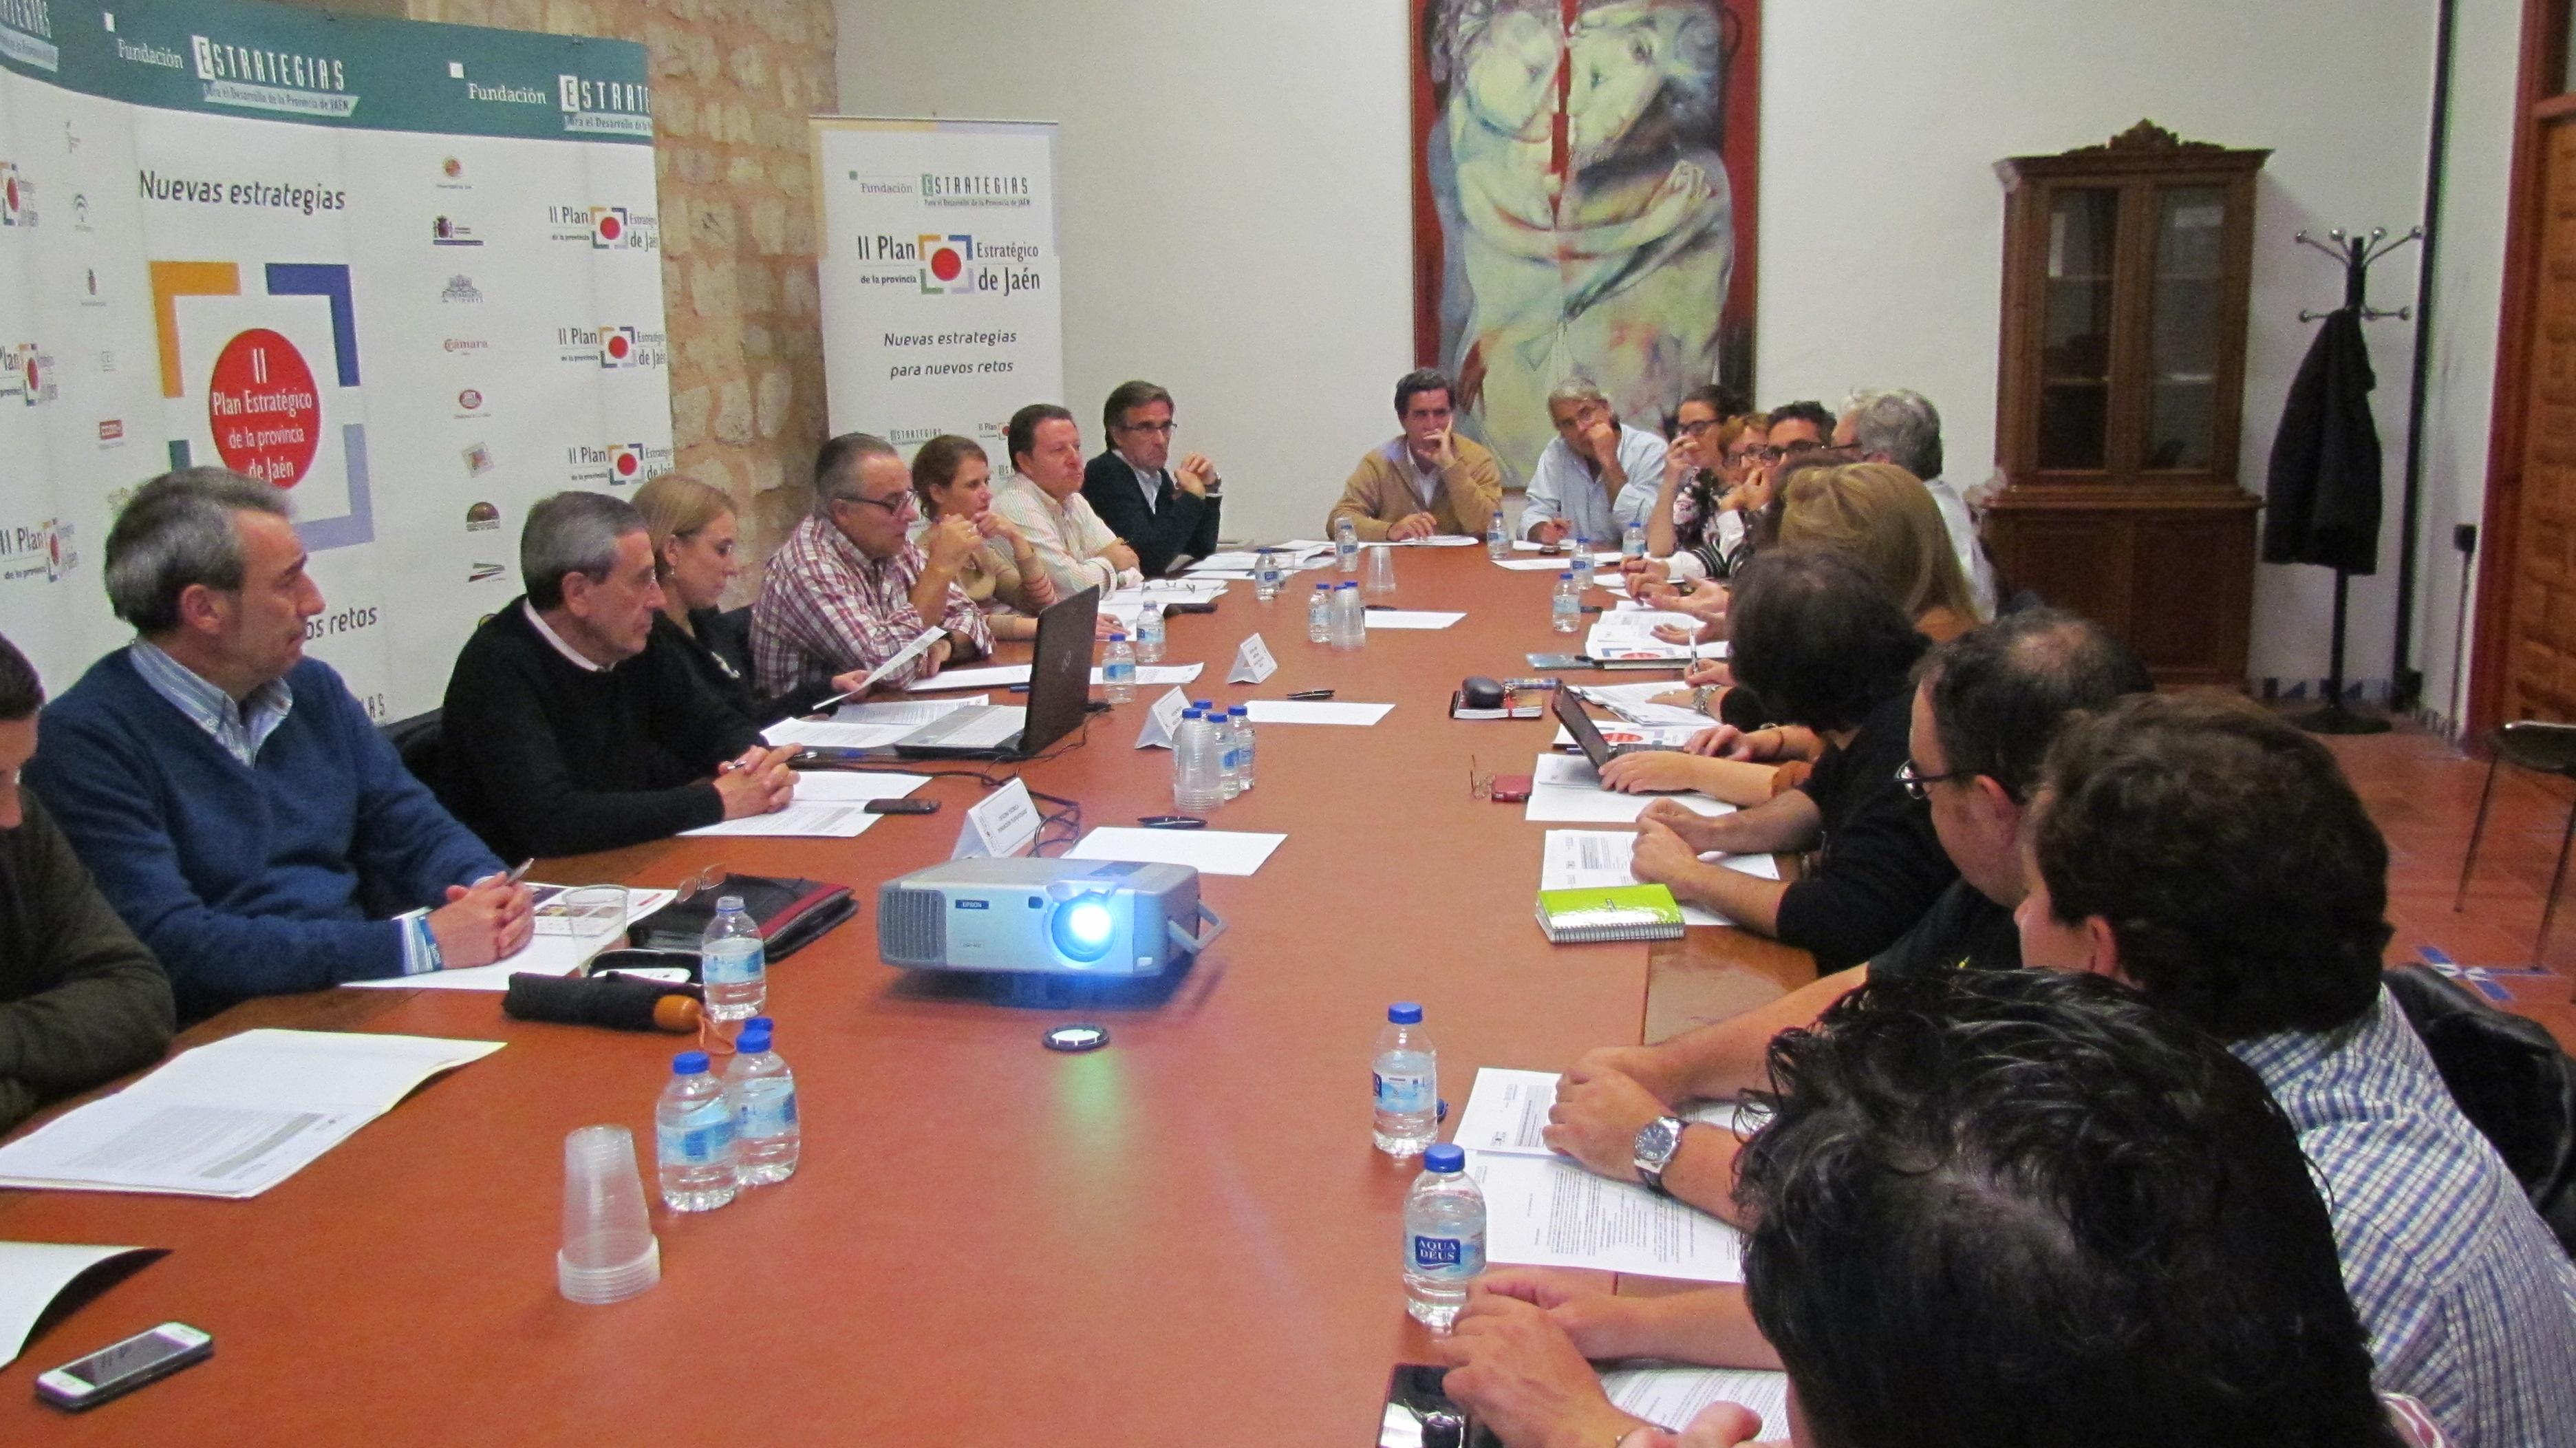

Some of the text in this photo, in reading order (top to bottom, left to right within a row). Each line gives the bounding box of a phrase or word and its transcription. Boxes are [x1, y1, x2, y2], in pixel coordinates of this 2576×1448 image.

[117, 35, 345, 92] Fundación ESTRATEGIAS
[468, 82, 548, 105] Fundación
[140, 169, 346, 216] Nuevas estrategias
[861, 173, 1029, 196] Fundación ESTRATEGIAS
[561, 206, 589, 224] Plan
[630, 231, 643, 248] de
[857, 235, 1039, 263] II Plan Estratégico
[861, 274, 917, 286] de la provincia
[978, 266, 1040, 297] de Jaén
[571, 327, 597, 345] Plan
[884, 329, 1017, 347] Nuevas estrategias
[253, 348, 268, 384] II
[638, 349, 650, 365] de
[890, 360, 1013, 380] para nuevos retos
[213, 387, 312, 418] Plan Estratégico
[228, 424, 305, 452] de la provincia
[581, 447, 606, 463] Plan
[248, 456, 294, 482] de Jaén
[330, 606, 378, 635] retos
[1419, 1239, 1457, 1251] AQUA
[1419, 1249, 1455, 1260] DEUS
